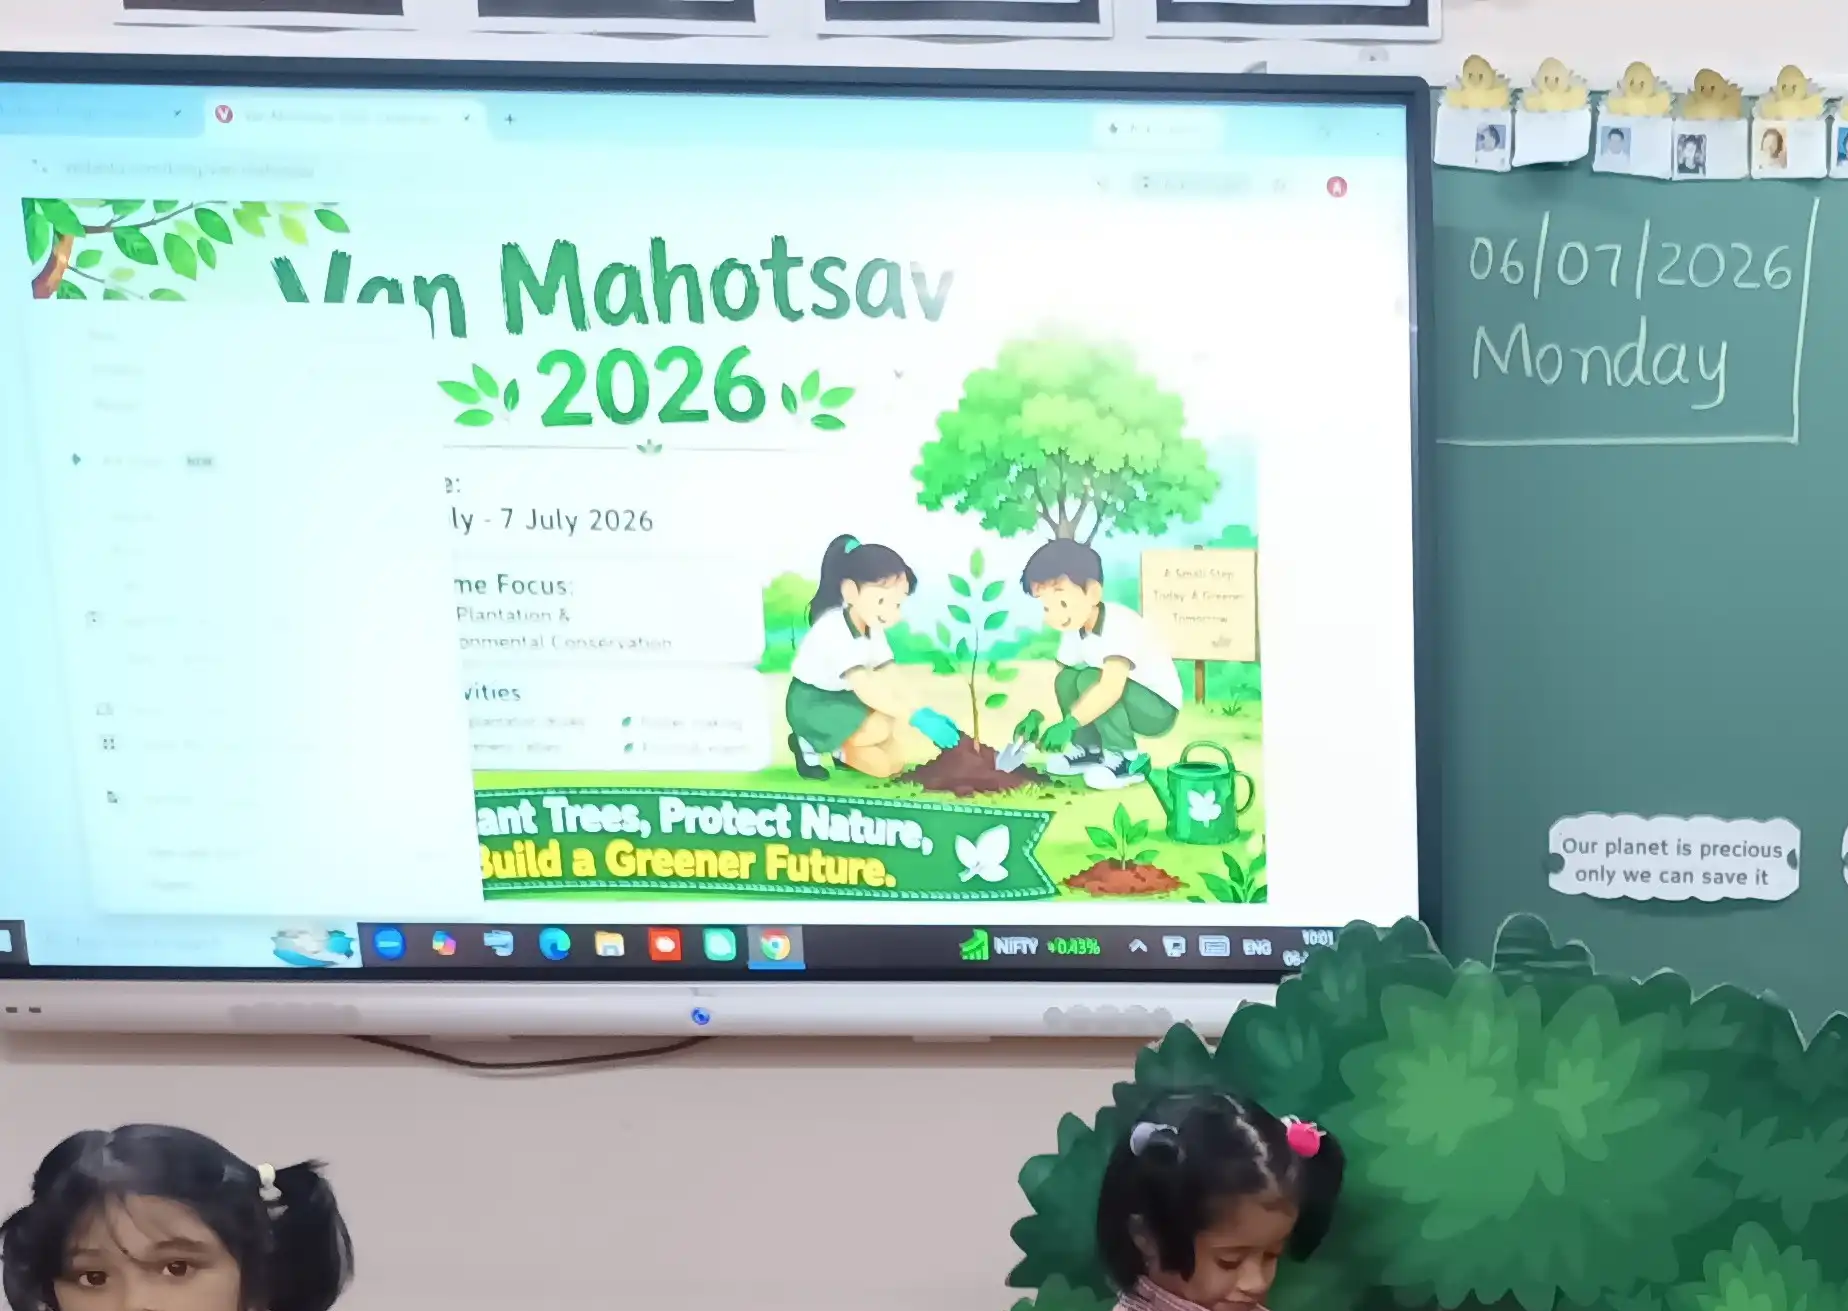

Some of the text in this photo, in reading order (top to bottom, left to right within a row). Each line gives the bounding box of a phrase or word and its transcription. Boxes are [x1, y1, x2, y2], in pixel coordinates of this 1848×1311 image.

[1469, 210, 1792, 300] 06/07/2026
[501, 235, 955, 335] Mahotsav
[1473, 314, 1727, 410] Monday
[537, 345, 767, 427] 2026
[500, 508, 512, 529] 7
[526, 508, 578, 537] July
[590, 509, 653, 532] 2026
[497, 573, 573, 597] Focus:
[456, 606, 551, 622] Plantation
[543, 796, 652, 839] Trees,
[659, 796, 792, 838] Protect
[800, 803, 934, 856] Nature,
[572, 847, 597, 877] a
[605, 838, 756, 880] Greener
[765, 843, 896, 887] Future.
[1561, 838, 1783, 863] Our planet is precious
[1575, 866, 1769, 886] only we can save it
[994, 936, 1038, 954] NIFTY
[1243, 939, 1272, 956] ENG
